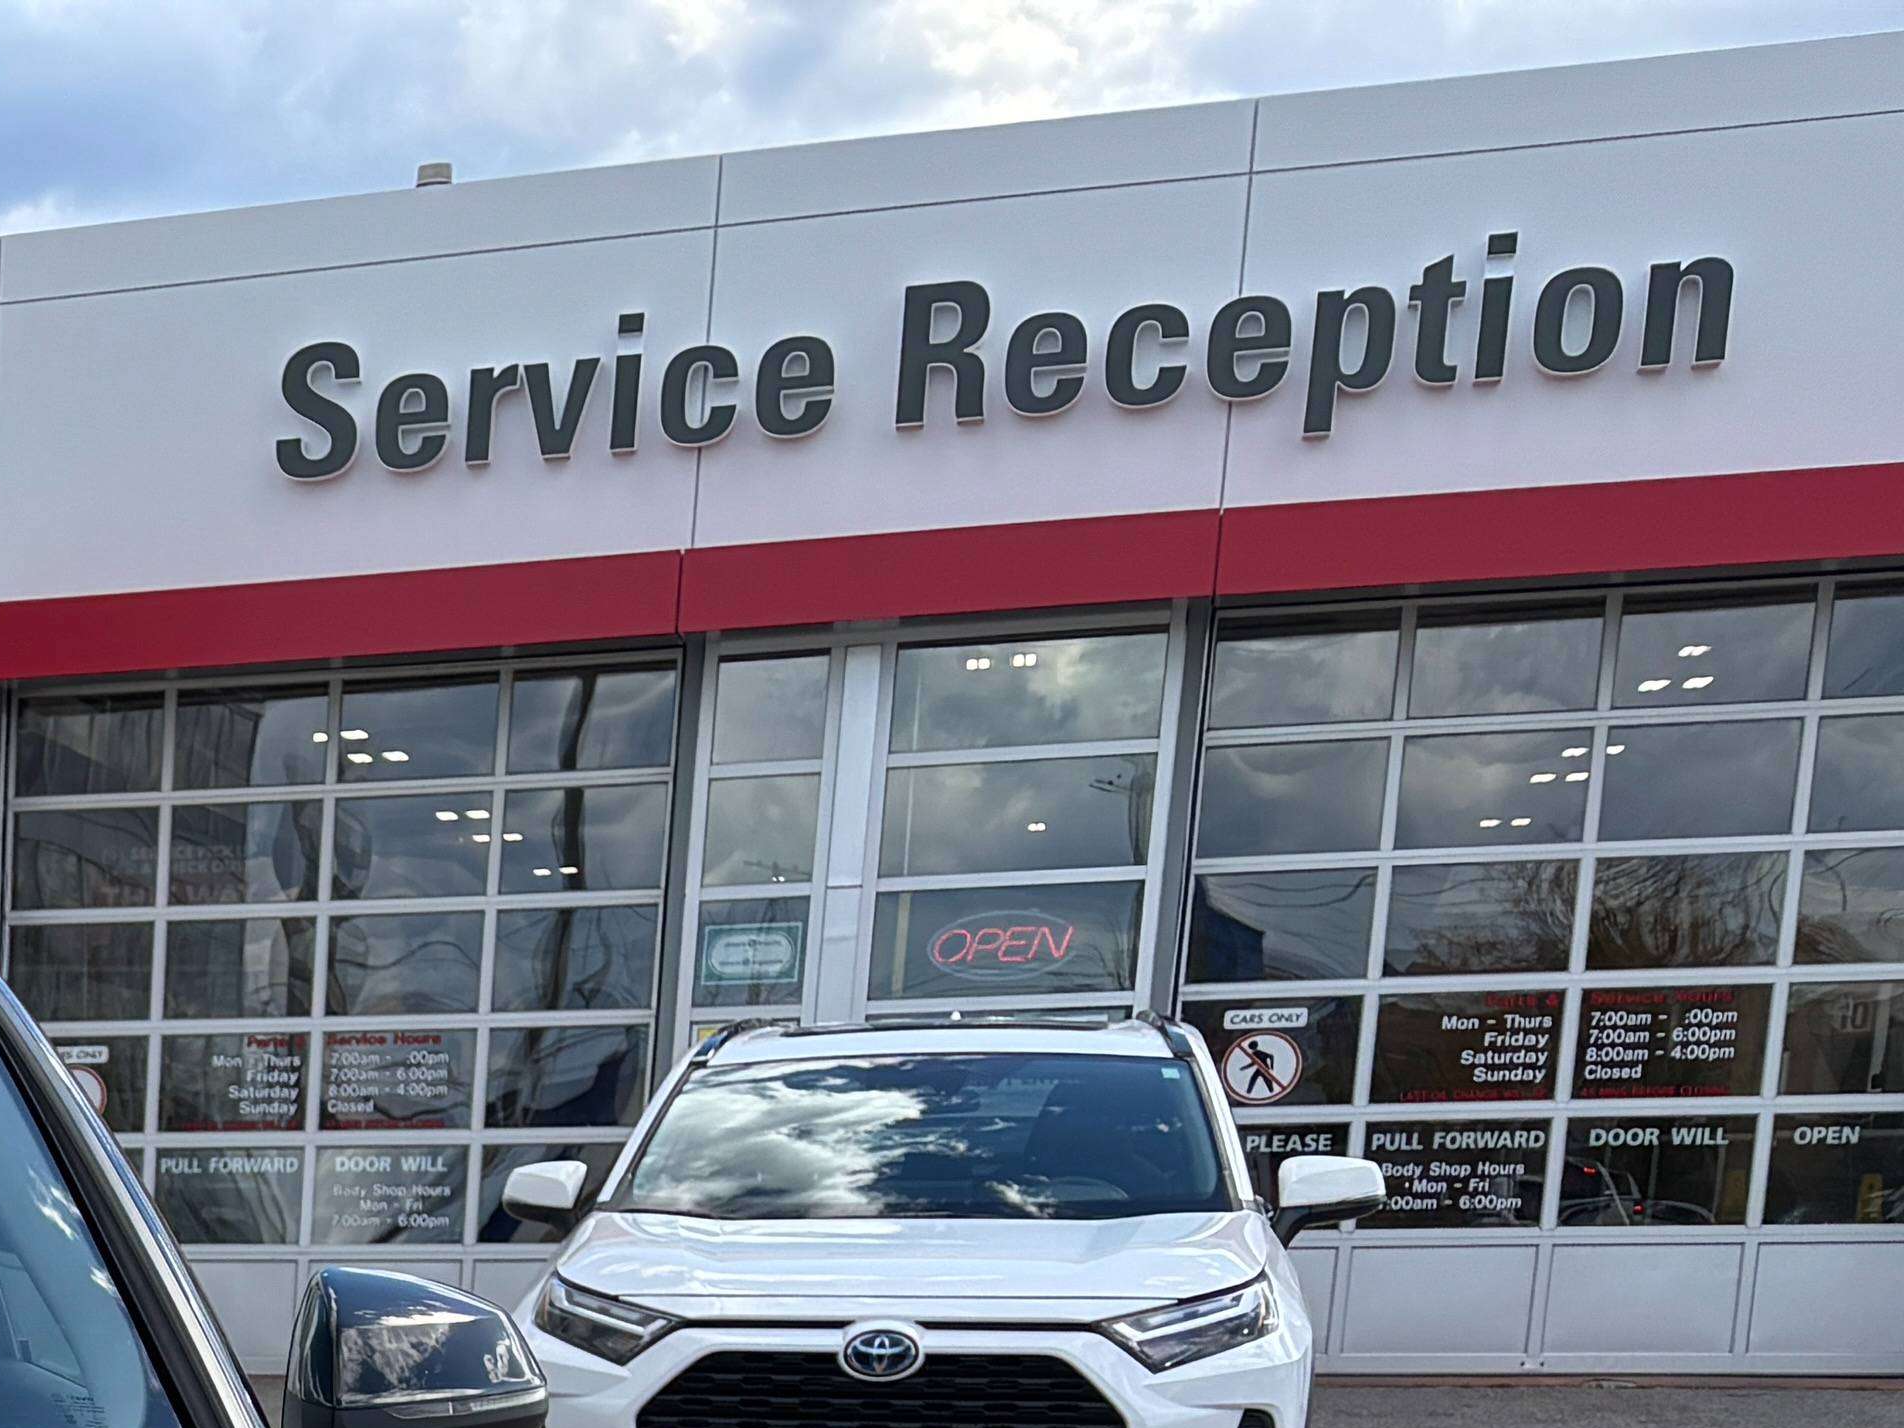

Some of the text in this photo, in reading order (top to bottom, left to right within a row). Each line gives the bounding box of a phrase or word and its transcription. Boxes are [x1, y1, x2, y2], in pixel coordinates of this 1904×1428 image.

[276, 232, 1735, 483] Service Reception
[933, 926, 1074, 965] OPEN
[1230, 1011, 1304, 1025] CARS ONLY
[1442, 1015, 1479, 1031] Mon
[1504, 1013, 1553, 1029] Thurs
[1590, 1011, 1652, 1026] 7:00am
[1484, 1031, 1550, 1048] Friday
[1587, 1029, 1650, 1044] 7:00am
[1672, 1027, 1736, 1043] 6:00pm
[212, 1055, 241, 1067] Mon
[263, 1053, 302, 1067] Thurs
[330, 1052, 380, 1065] 7:00am
[1460, 1049, 1549, 1066] Saturday
[1585, 1046, 1649, 1062] 8:00am
[1670, 1045, 1735, 1060] 4:00pm
[245, 1070, 299, 1084] Friday
[329, 1069, 379, 1081] 7:00am
[396, 1068, 448, 1081] 6:00pm
[1473, 1064, 1643, 1084] Sunday Closed
[228, 1085, 299, 1100] Saturday
[396, 1084, 448, 1098] 4:00pm
[239, 1099, 374, 1115] Sunday Closed
[1246, 1125, 1861, 1152] PLEASE PULL FORWARD DOOR WILL OPEN
[160, 1156, 448, 1175] PULL FORWARD DOOR WILL
[1382, 1160, 1525, 1179] Body Shop Hours
[372, 1183, 407, 1197] Shop
[412, 1183, 451, 1197] Hours
[1412, 1179, 1448, 1193] Mon
[1469, 1178, 1490, 1192] Fri
[360, 1199, 388, 1211] Mon
[405, 1199, 423, 1211] Fri
[1381, 1197, 1438, 1211] :00am
[1459, 1195, 1522, 1211] 6:00pm
[398, 1214, 450, 1229] 6:00pm
